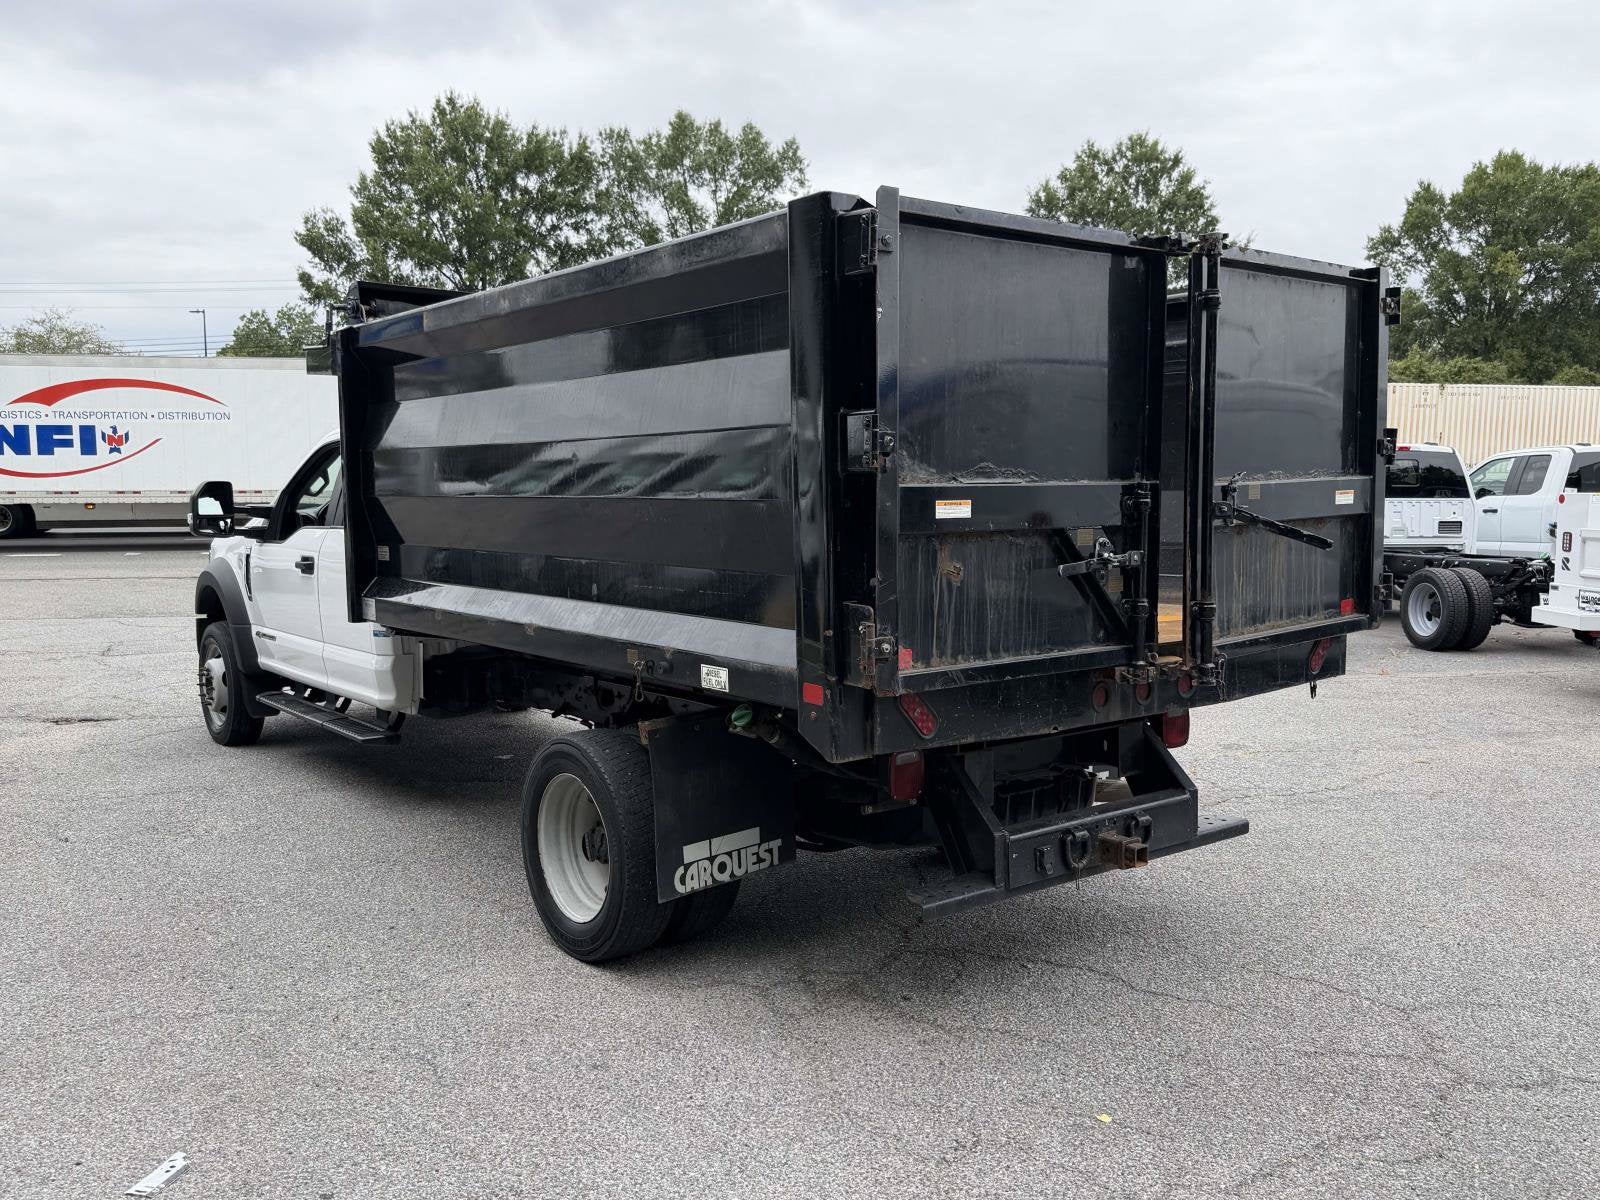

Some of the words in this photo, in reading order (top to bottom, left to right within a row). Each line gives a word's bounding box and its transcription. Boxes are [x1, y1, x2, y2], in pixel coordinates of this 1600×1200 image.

[52, 410, 148, 420] TRANSPORTATION
[157, 411, 231, 421] DISTRIBUTION
[0, 424, 97, 456] NFI
[674, 839, 782, 893] CARQUEST
